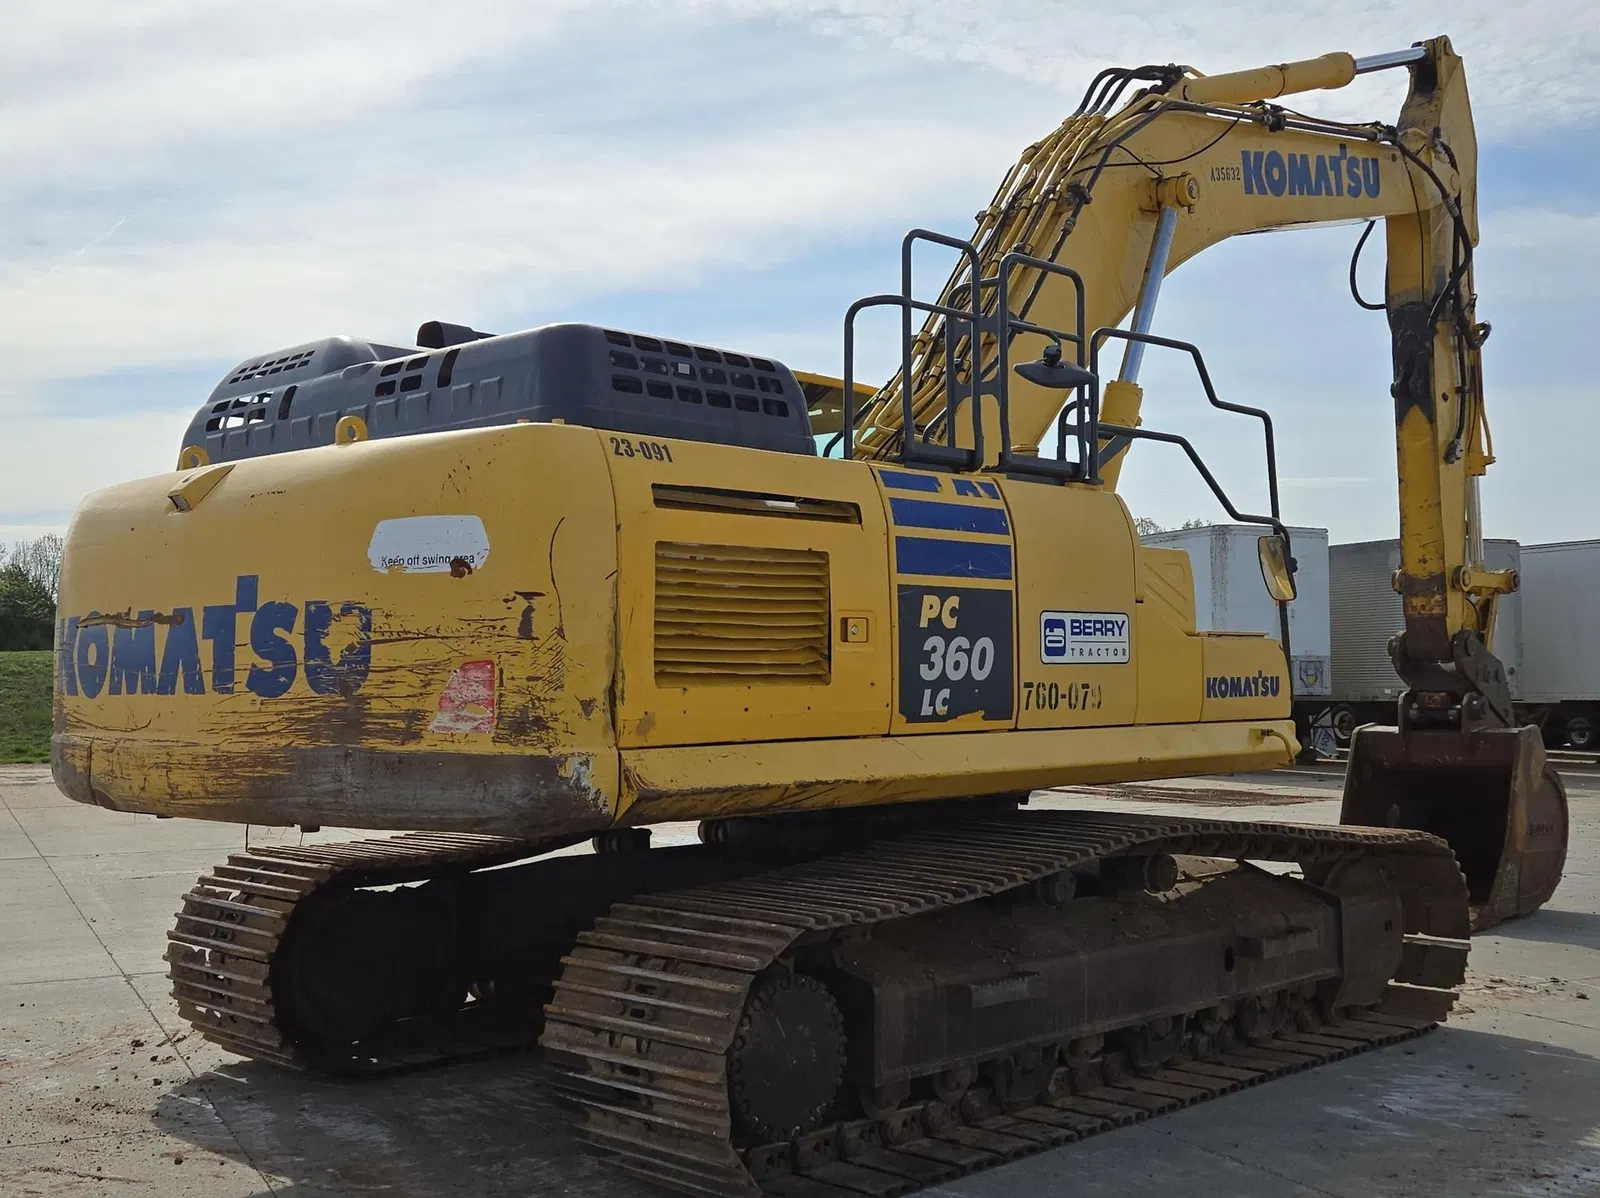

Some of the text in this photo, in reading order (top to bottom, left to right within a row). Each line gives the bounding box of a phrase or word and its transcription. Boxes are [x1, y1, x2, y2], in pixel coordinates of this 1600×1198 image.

[1210, 166, 1241, 182] A35632
[1241, 143, 1380, 199] KOMATSU
[608, 436, 673, 463] 23-091
[407, 554, 420, 566] off
[422, 553, 451, 565] swing
[919, 594, 960, 629] PC
[57, 574, 372, 699] KOMATSU
[1070, 619, 1126, 637] BERRY
[919, 635, 995, 681] 360
[1070, 648, 1127, 657] TRACTOR
[1206, 669, 1280, 699] KOMATSU
[920, 688, 951, 716] LC
